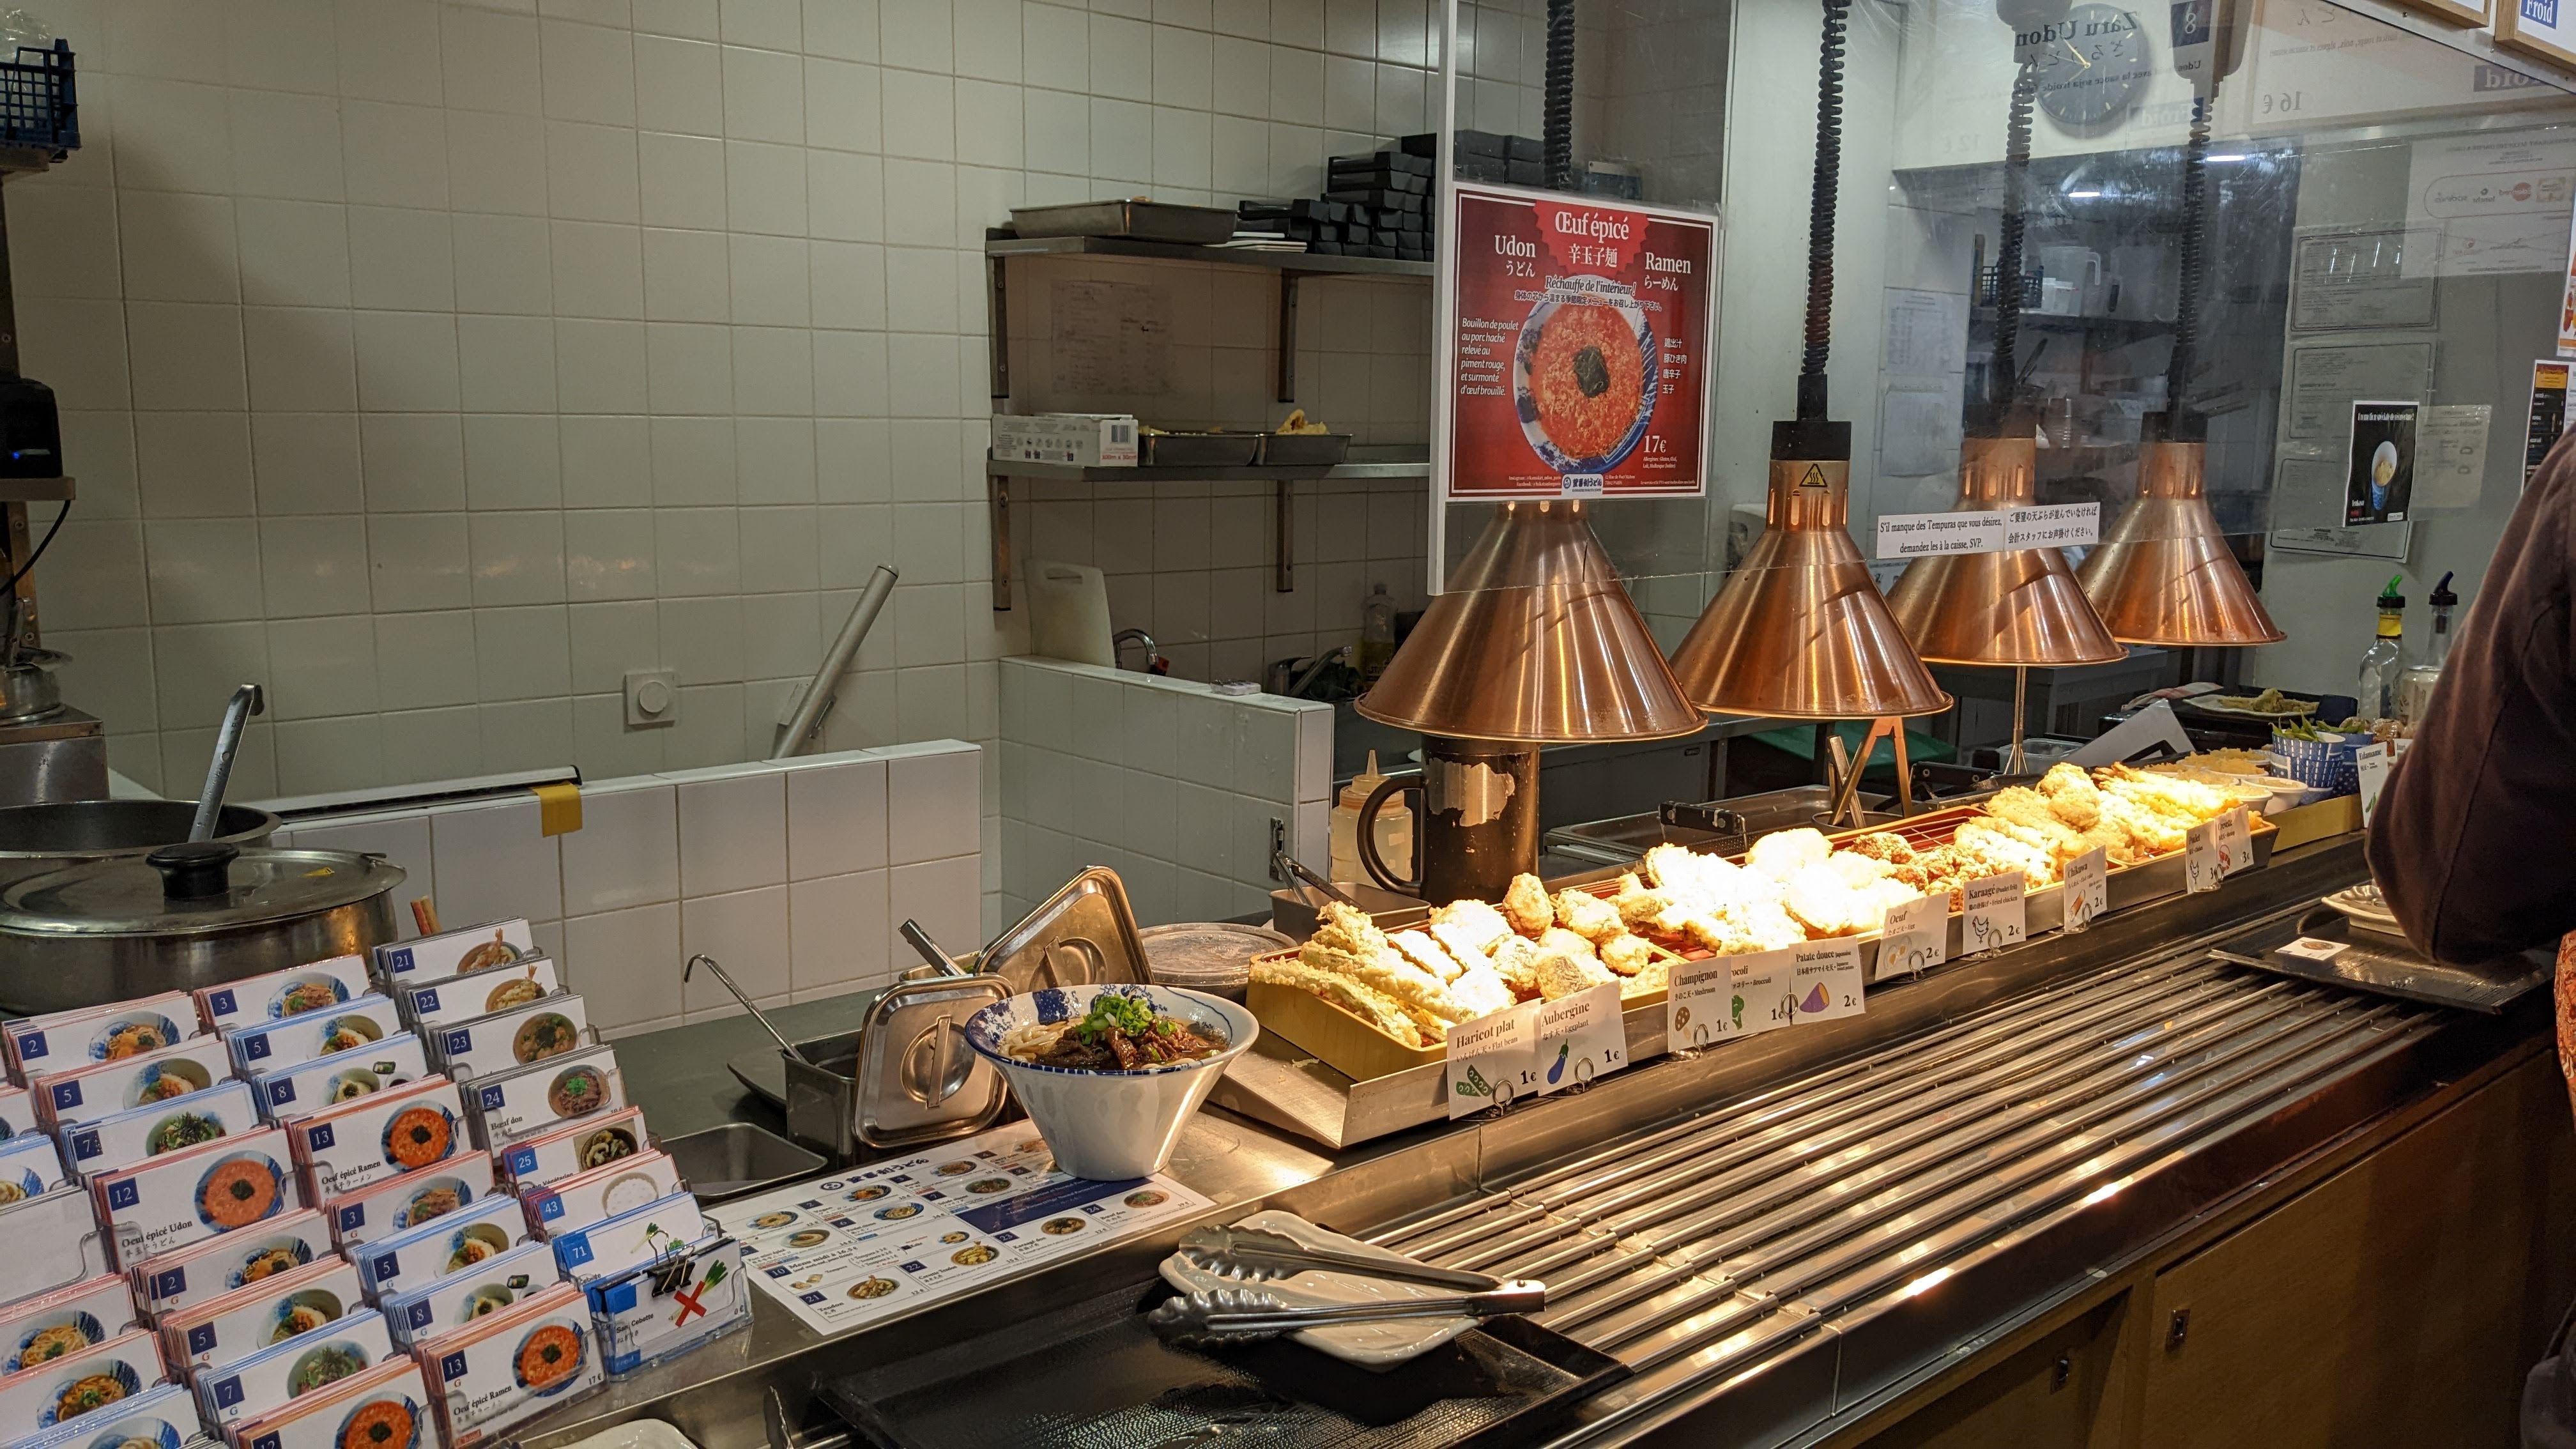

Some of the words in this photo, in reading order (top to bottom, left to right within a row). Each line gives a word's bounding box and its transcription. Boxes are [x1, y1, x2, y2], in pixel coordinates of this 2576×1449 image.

[2526, 0, 2553, 23] Froid
[1555, 211, 1589, 235] Œuf
[1590, 212, 1629, 243] épicé
[1495, 234, 1536, 257] Udon
[1506, 259, 1535, 278] うどん
[1645, 252, 1691, 274] Ramen
[1545, 274, 1584, 293] Réchauffe
[1585, 280, 1594, 293] de
[1644, 275, 1679, 291] らーめん
[1462, 318, 1489, 328] Bouillon
[1490, 319, 1497, 328] de
[1498, 320, 1519, 332] poulet
[1471, 334, 1485, 343] porc
[1486, 332, 1505, 342] haché
[1461, 344, 1480, 355] relevé
[1461, 358, 1485, 370] piment
[1486, 362, 1505, 371] rouge,
[1461, 372, 1468, 381] et
[1468, 372, 1499, 382] surmonté
[1460, 385, 1480, 395] d'œuf
[1480, 385, 1505, 395] brouillé.
[1662, 385, 1674, 394] 玉子
[1880, 522, 1890, 532] S'il
[1891, 524, 1915, 533] manque
[1916, 521, 1926, 530] des
[1928, 520, 1956, 532] Tempuras
[1958, 521, 1968, 530] que
[1982, 516, 2002, 526] désirez,
[1900, 542, 1929, 553] demandez
[1939, 541, 1943, 550] à
[1944, 540, 1949, 549] la
[1951, 539, 1968, 549] caisse,
[1970, 538, 1982, 548] SVP.
[2068, 864, 2088, 878] Chikuwa
[1968, 884, 1995, 900] Karaagé
[1890, 910, 1908, 924] Oeuf
[2008, 925, 2014, 936] 2
[1796, 953, 1816, 962] Patate
[1816, 951, 1834, 959] douce
[1926, 947, 1933, 959] 2
[396, 954, 410, 967] 21
[1674, 970, 1718, 987] Champignon
[219, 997, 227, 1009] 3
[420, 995, 435, 1008] 22
[1844, 995, 1850, 1007] 2
[1541, 1001, 1590, 1027] Aubergine
[1456, 1027, 1494, 1048] Haricot
[1496, 1018, 1515, 1036] plat
[1564, 1019, 1589, 1034] Eggplant
[30, 1039, 38, 1053] 2
[254, 1041, 261, 1054] 5
[453, 1036, 467, 1049] 23
[1492, 1041, 1503, 1050] Flat
[1503, 1036, 1518, 1047] bean
[1604, 1048, 1612, 1063] 1
[1521, 1070, 1528, 1085] 1
[64, 1089, 72, 1103] 5
[278, 1086, 287, 1098] 8
[486, 1092, 500, 1106] 24
[511, 1116, 523, 1125] don
[315, 1130, 329, 1145] 13
[82, 1139, 90, 1152] 7
[519, 1155, 532, 1169] 25
[322, 1174, 338, 1184] Oeuf
[340, 1167, 357, 1182] épicé
[358, 1161, 381, 1174] Ramen
[116, 1187, 132, 1203] 12
[546, 1201, 558, 1213] 43
[349, 1211, 356, 1224] 3
[146, 1227, 168, 1241] épicé
[169, 1220, 192, 1232] Udon
[350, 1230, 358, 1238] G
[572, 1246, 586, 1259] 71
[384, 1261, 390, 1274] 5
[788, 1260, 811, 1269] Menu
[813, 1254, 830, 1264] midi
[771, 1268, 785, 1276] 10
[168, 1276, 176, 1290] 2
[171, 1296, 179, 1304] G
[806, 1294, 820, 1303] 21
[818, 1302, 845, 1312] Tendon
[417, 1309, 424, 1322] 8
[631, 1314, 654, 1326] Cebette
[199, 1332, 206, 1346] 5
[420, 1328, 427, 1337] G
[202, 1353, 210, 1361] G
[448, 1359, 462, 1375] 13
[588, 1377, 597, 1386] 17
[224, 1385, 233, 1400] 7
[471, 1393, 488, 1408] épicé
[489, 1385, 512, 1400] Ramen
[230, 1406, 238, 1415] G
